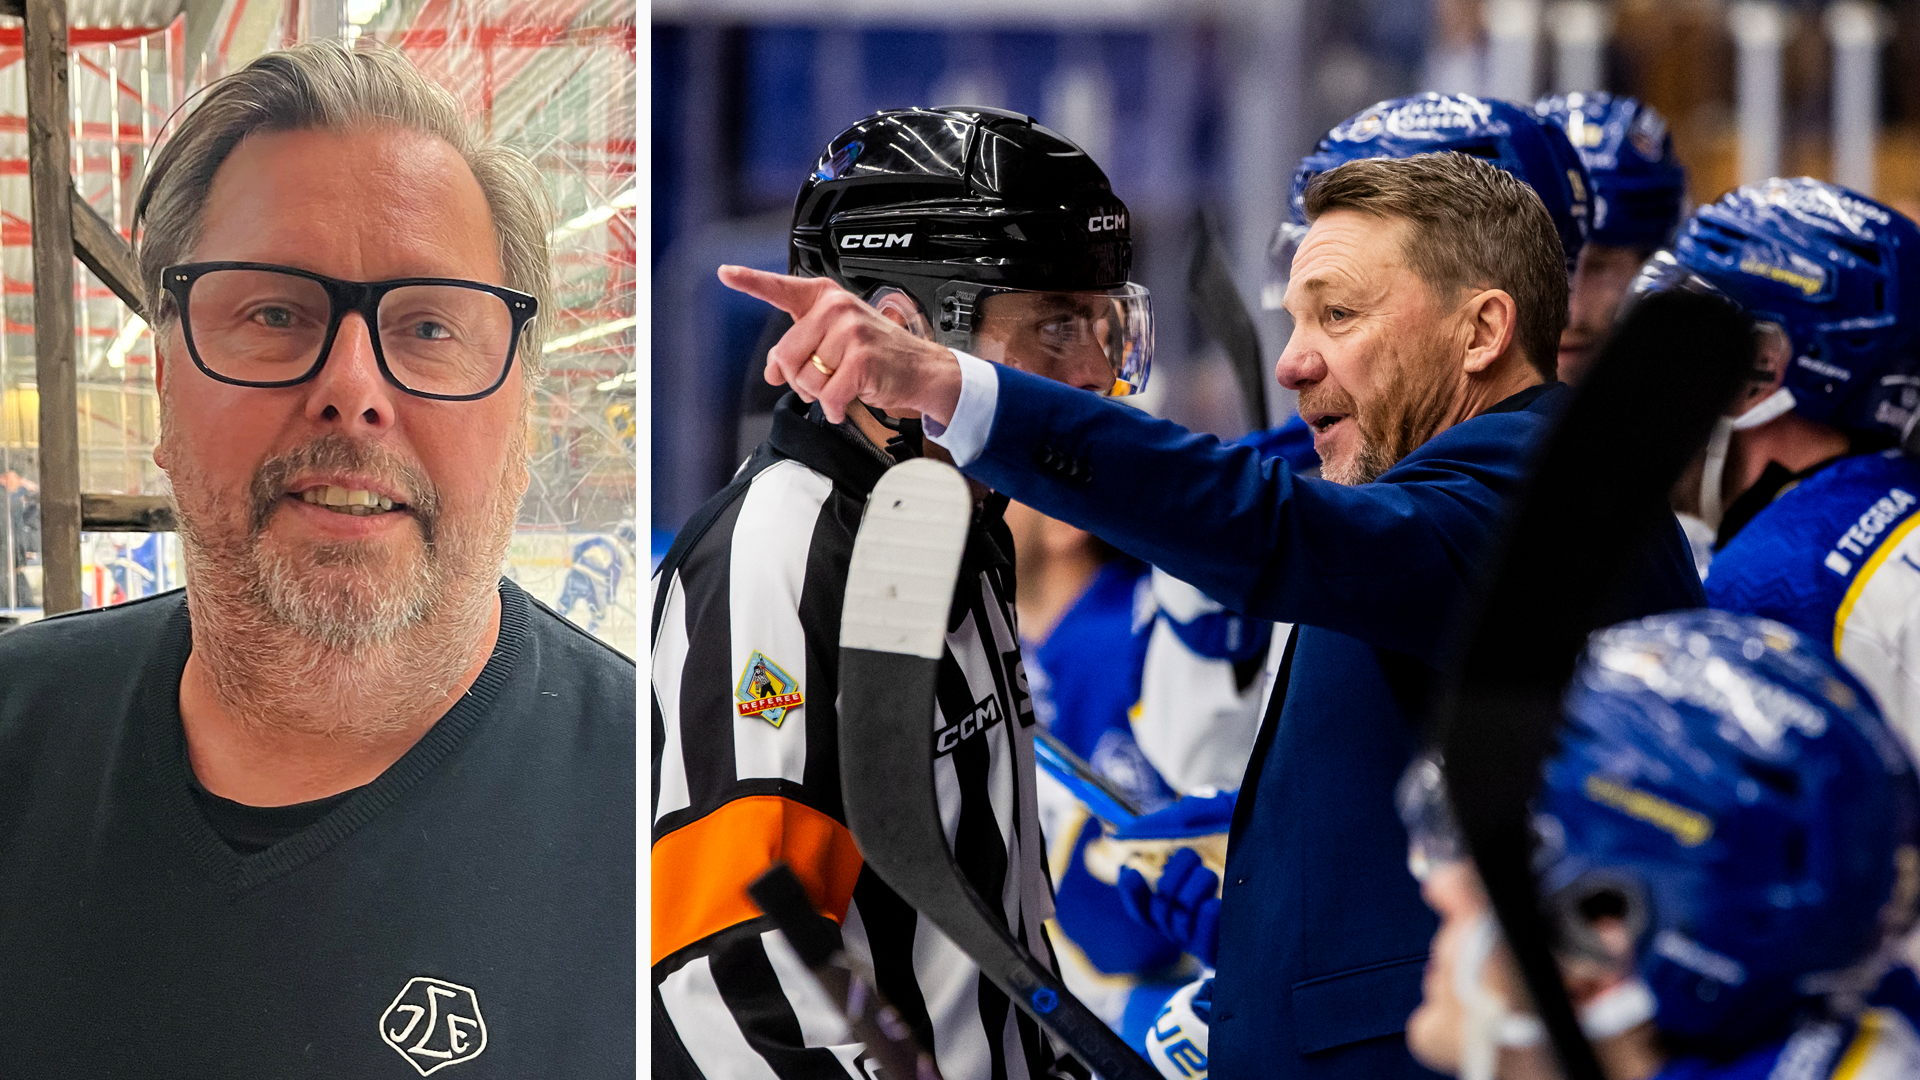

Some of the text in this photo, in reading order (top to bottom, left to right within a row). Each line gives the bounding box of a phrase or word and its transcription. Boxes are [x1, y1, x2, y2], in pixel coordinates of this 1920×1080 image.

[1088, 214, 1125, 232] CCM
[840, 233, 913, 249] CCM
[741, 693, 800, 711] REFEREE
[936, 699, 997, 753] CCM
